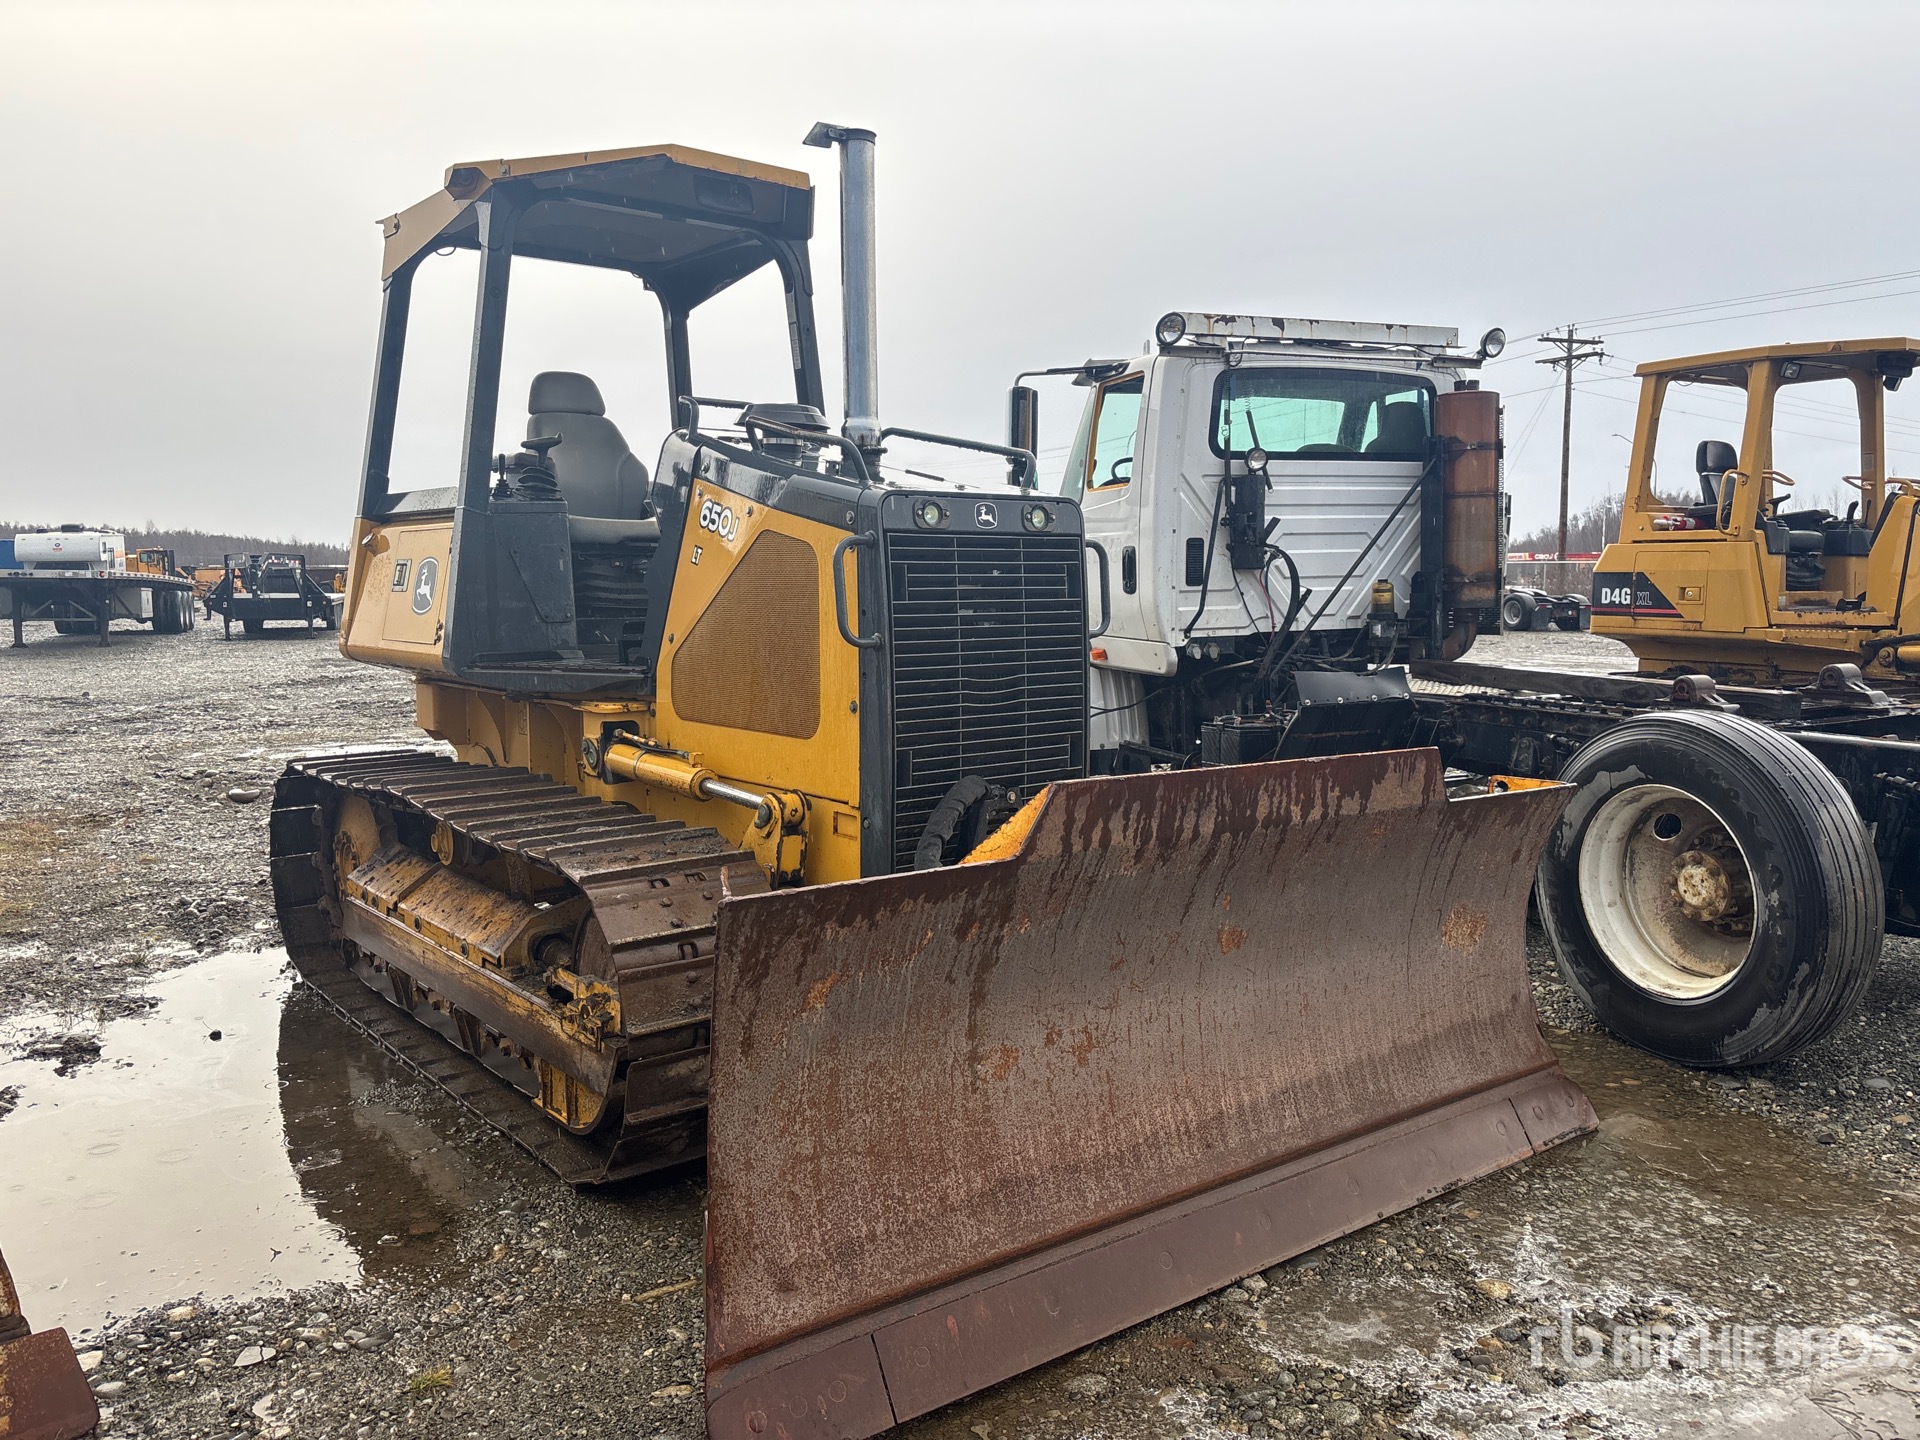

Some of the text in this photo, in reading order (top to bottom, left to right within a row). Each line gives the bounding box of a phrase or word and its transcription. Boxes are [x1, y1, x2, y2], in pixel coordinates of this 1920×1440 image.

[699, 498, 740, 542] 650J
[691, 545, 703, 566] LT
[1601, 587, 1652, 606] D4G XL
